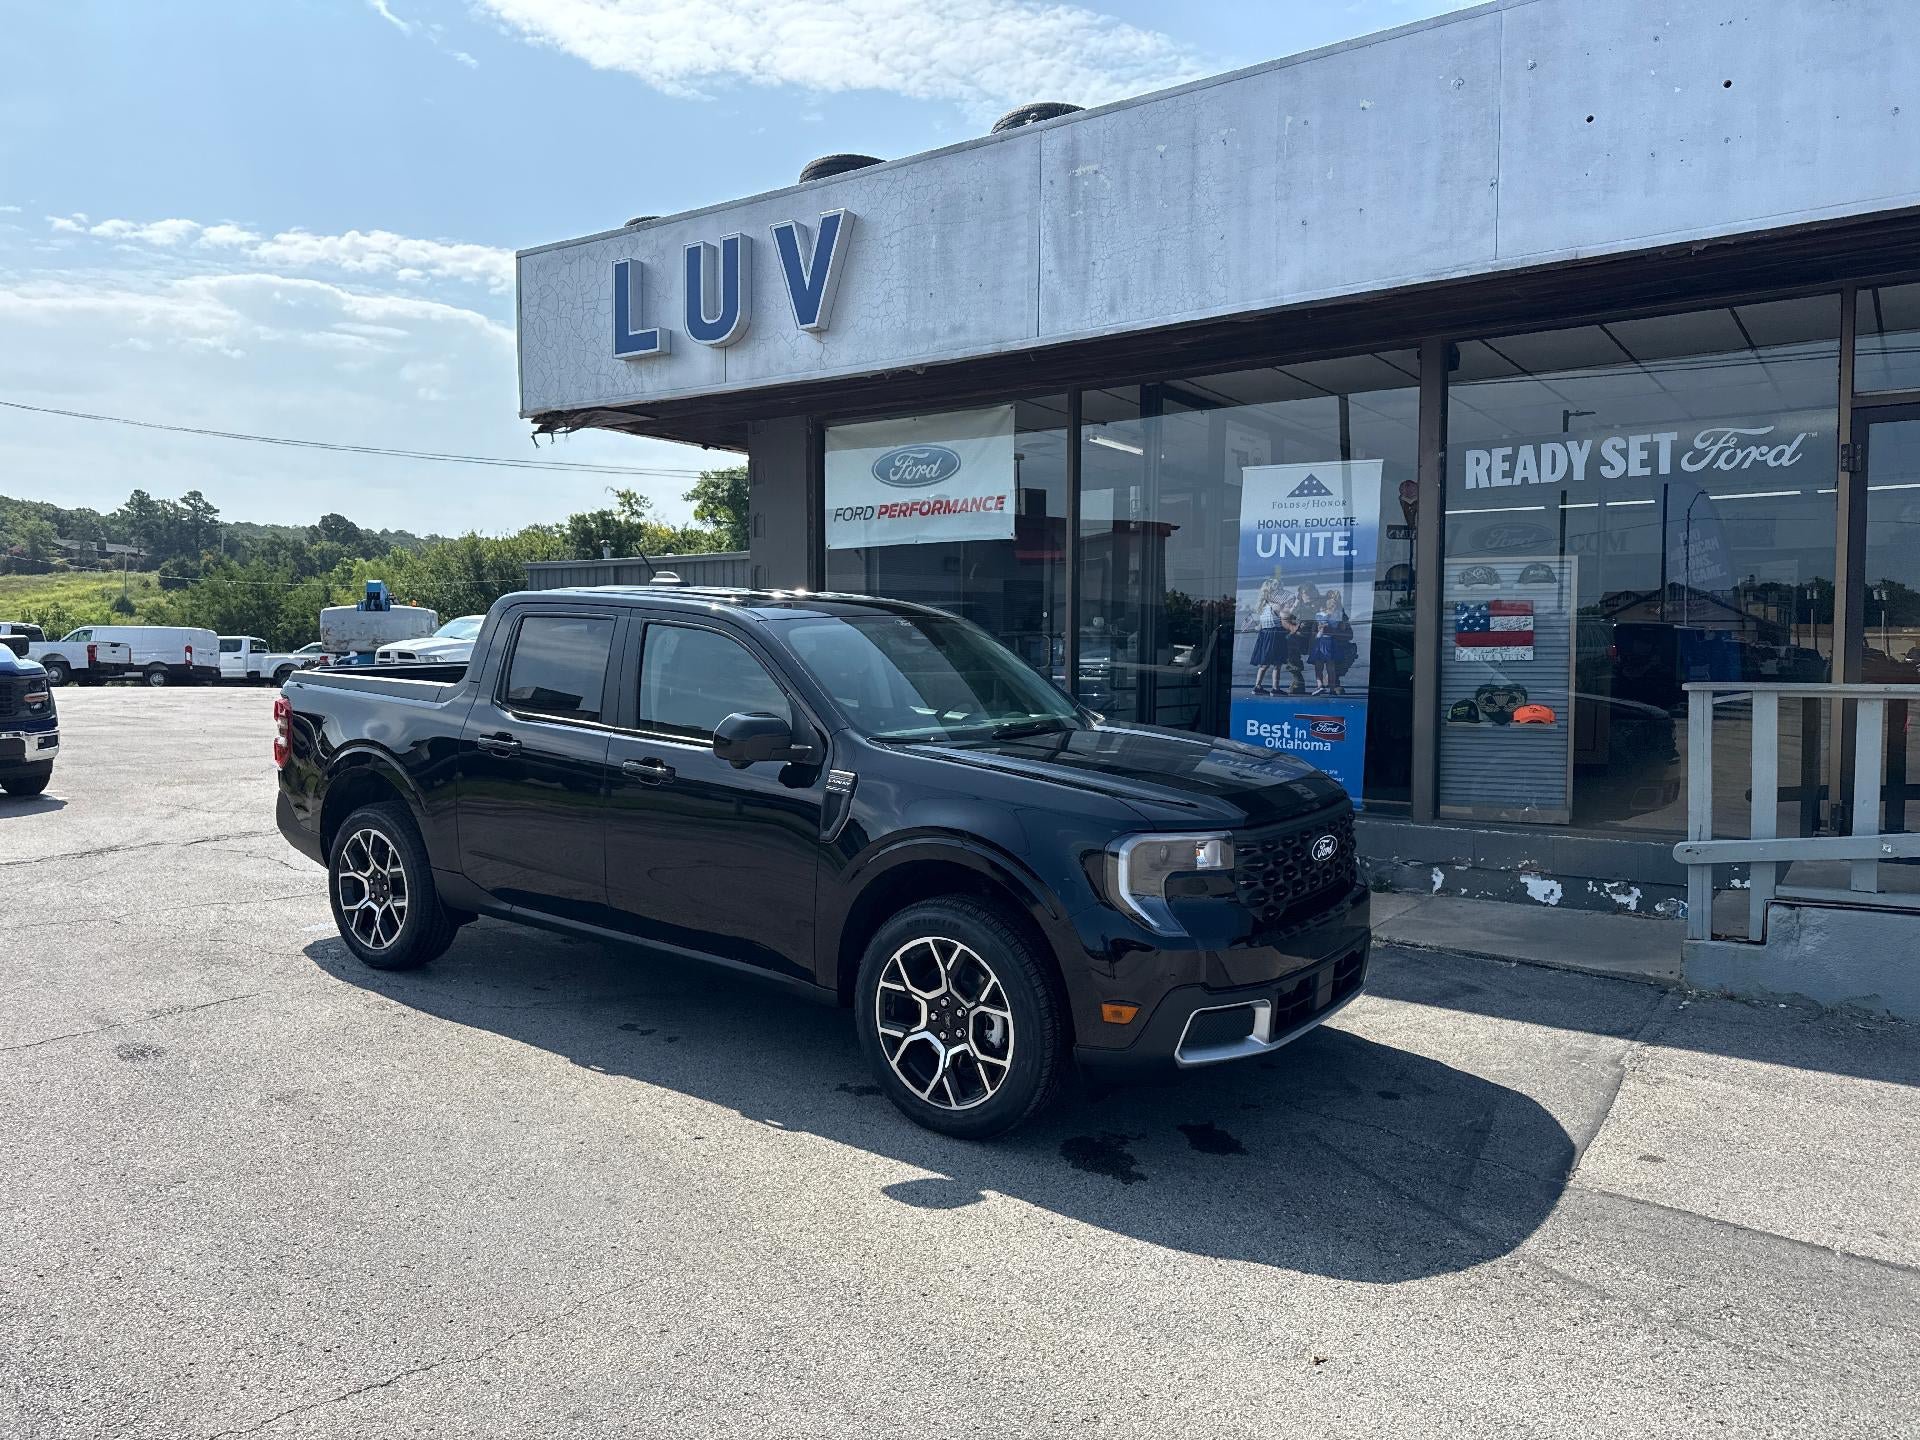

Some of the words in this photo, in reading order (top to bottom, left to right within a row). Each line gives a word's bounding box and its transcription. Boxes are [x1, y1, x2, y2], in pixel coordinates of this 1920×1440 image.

[612, 208, 857, 360] LUV
[889, 452, 942, 482] Ford
[1465, 439, 1592, 490] READY
[1600, 431, 1678, 480] SET
[1680, 425, 1807, 473] Ford
[834, 506, 875, 523] FORD
[877, 495, 1007, 520] PERFORMANCE
[1257, 519, 1301, 530] HONOR.
[1304, 517, 1360, 528] EDUCATE.
[1256, 531, 1358, 558] UNITE.
[1246, 719, 1291, 738] Best
[1316, 722, 1340, 733] Ford
[1265, 737, 1331, 751] Oklahoma
[1317, 839, 1334, 858] Ford
